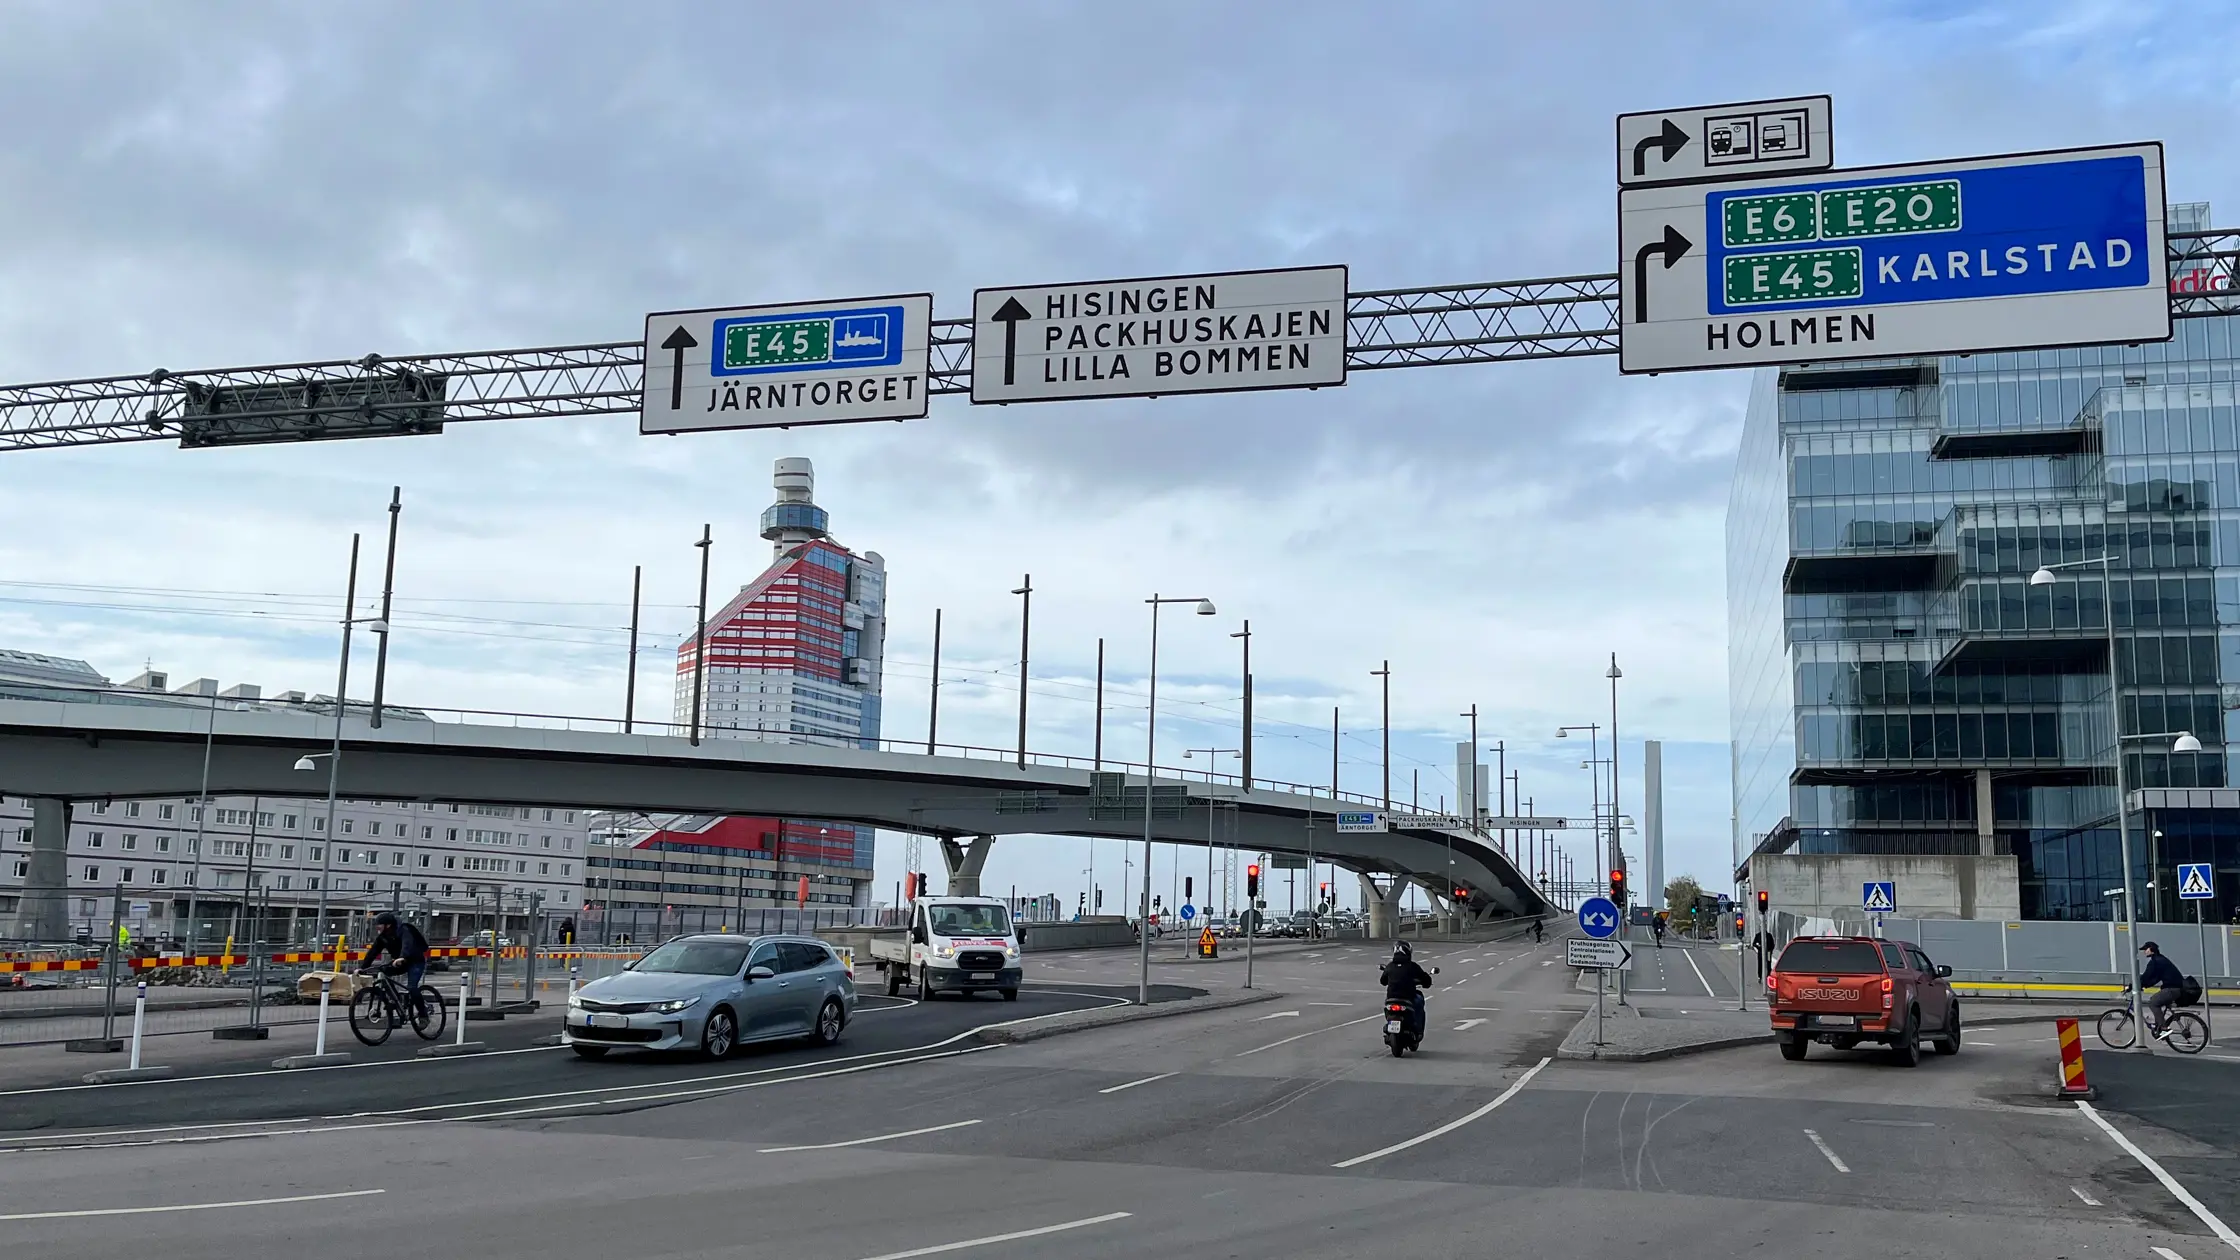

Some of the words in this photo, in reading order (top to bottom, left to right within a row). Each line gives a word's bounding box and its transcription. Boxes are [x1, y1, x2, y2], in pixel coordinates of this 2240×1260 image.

[1746, 205, 1796, 235] E6
[1847, 194, 1933, 227] E20
[1752, 260, 1834, 293] E45
[1878, 238, 2132, 284] KARLSTAD
[1047, 284, 1216, 319] HISINGEN
[746, 330, 809, 357] E45
[1046, 309, 1330, 351] PACKHUSKAJEN
[1707, 313, 1876, 351] HOLMEN
[1045, 354, 1130, 382] LILLA
[1155, 343, 1309, 377] BOMMEN
[707, 376, 918, 412] JÄRNTORGET
[1797, 988, 1860, 1001] ISUZU
